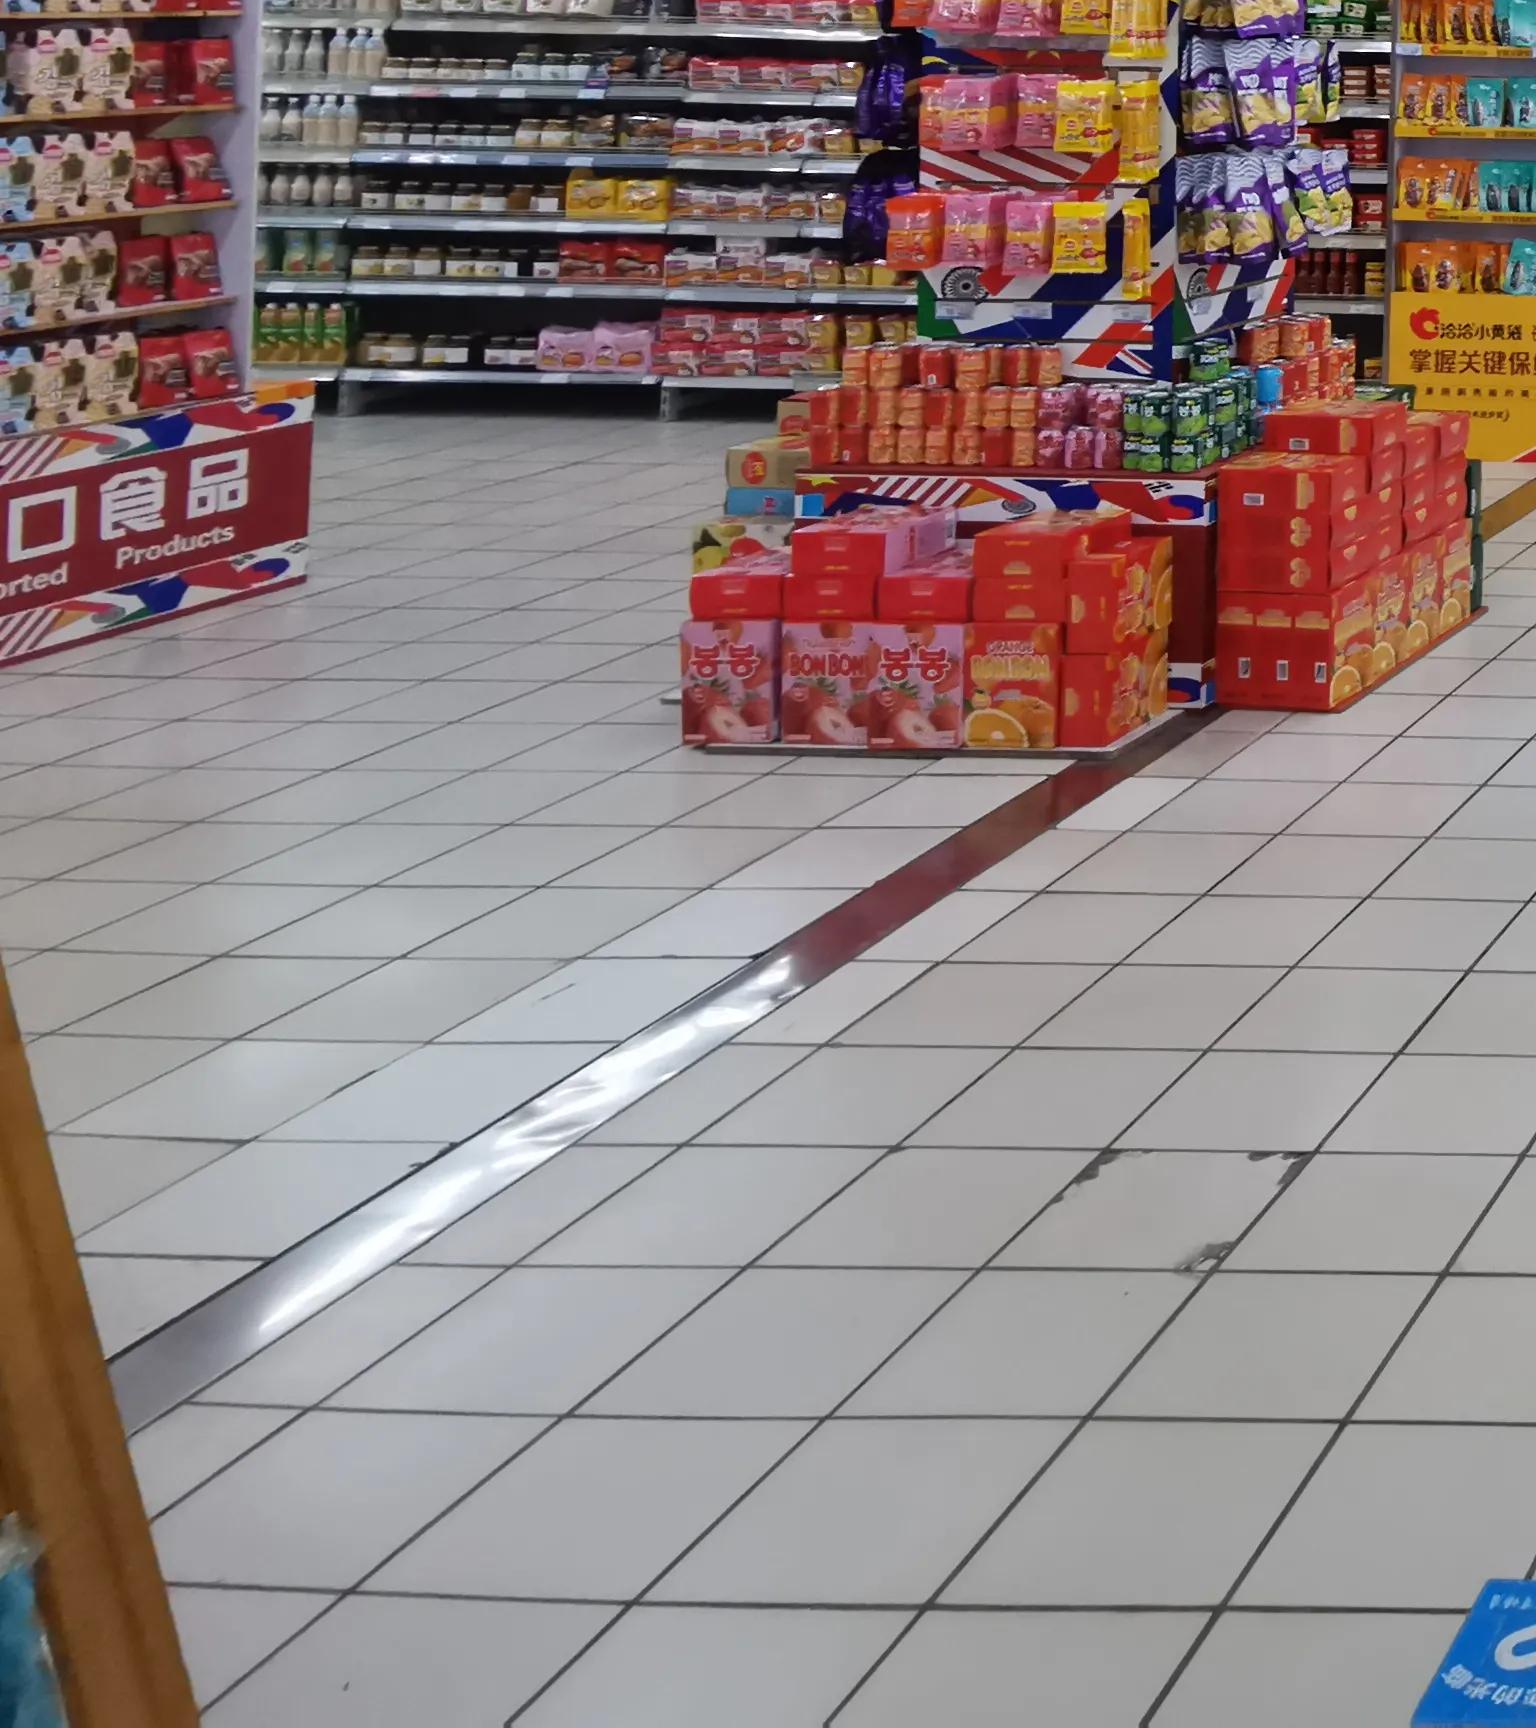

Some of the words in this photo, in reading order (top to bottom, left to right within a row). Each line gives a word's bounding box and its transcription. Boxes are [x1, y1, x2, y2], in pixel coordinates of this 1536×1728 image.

[115, 525, 235, 570] Products
[690, 645, 761, 680] 봉봉
[880, 647, 952, 682] 봉봉
